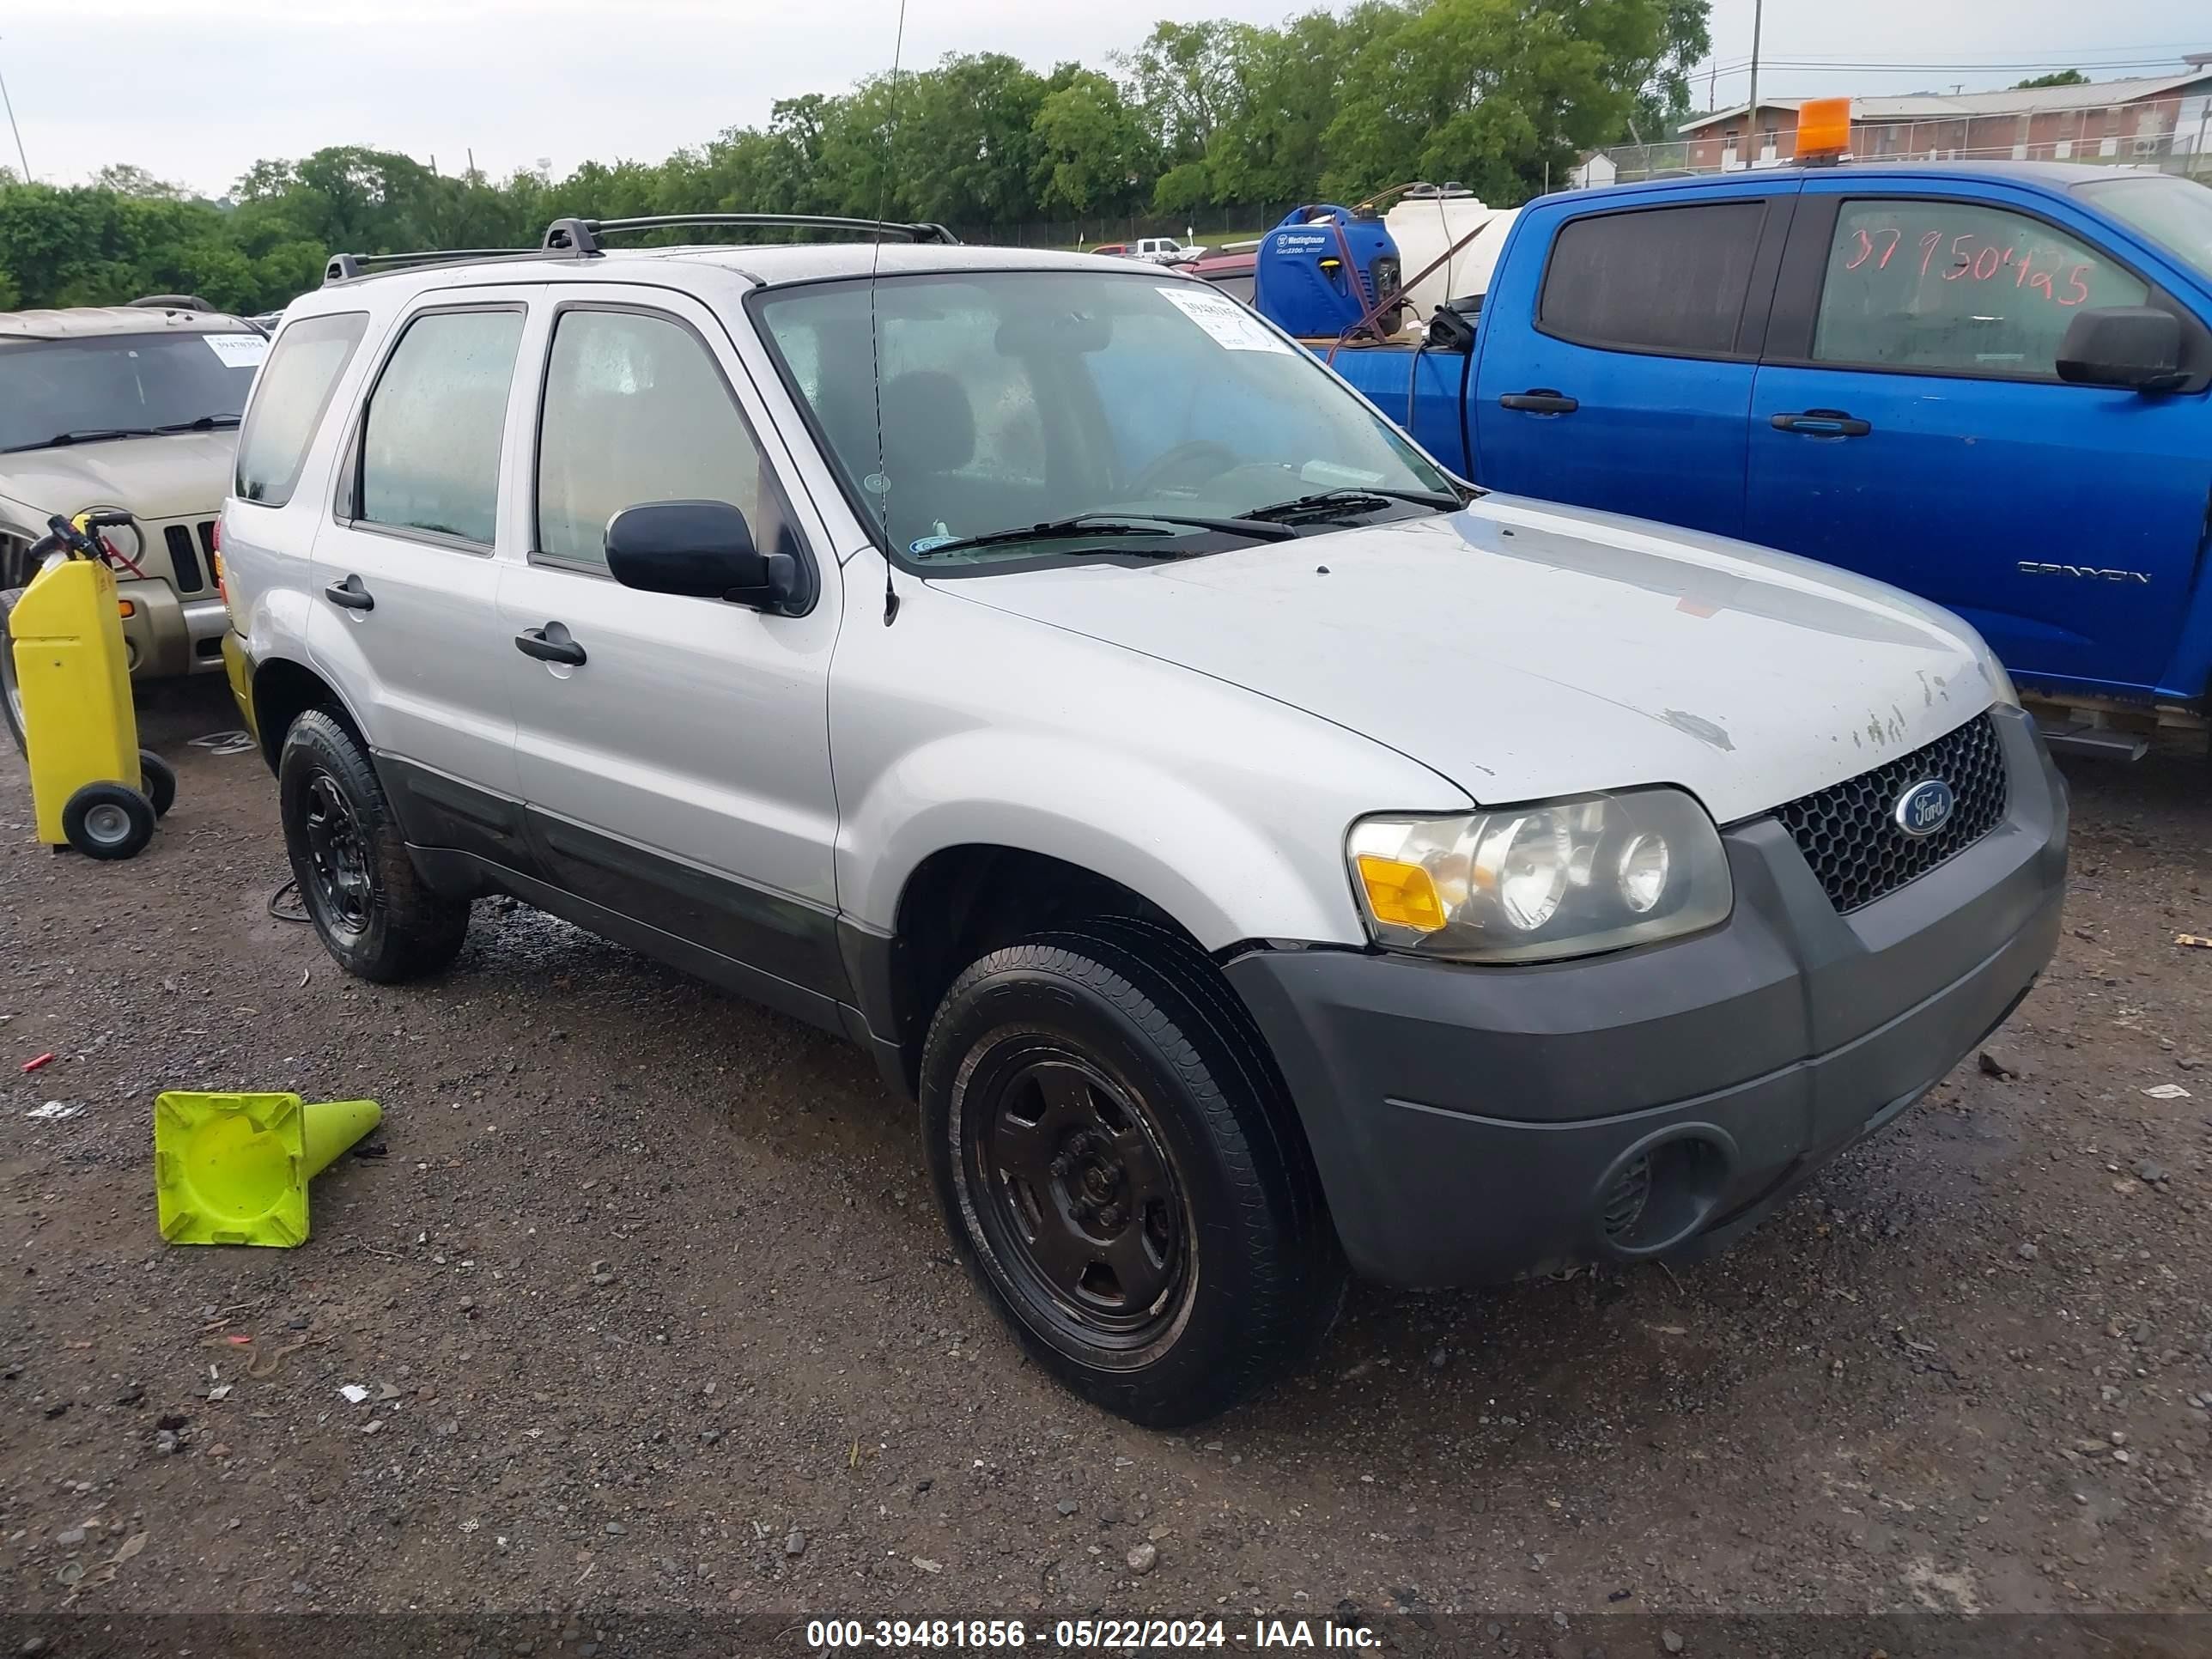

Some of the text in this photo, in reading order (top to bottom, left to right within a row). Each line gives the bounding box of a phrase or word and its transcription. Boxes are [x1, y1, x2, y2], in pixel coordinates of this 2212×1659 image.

[1288, 236, 1326, 246] Westinghouse
[2018, 561, 2153, 584] CANYON
[1914, 791, 1946, 827] Ford
